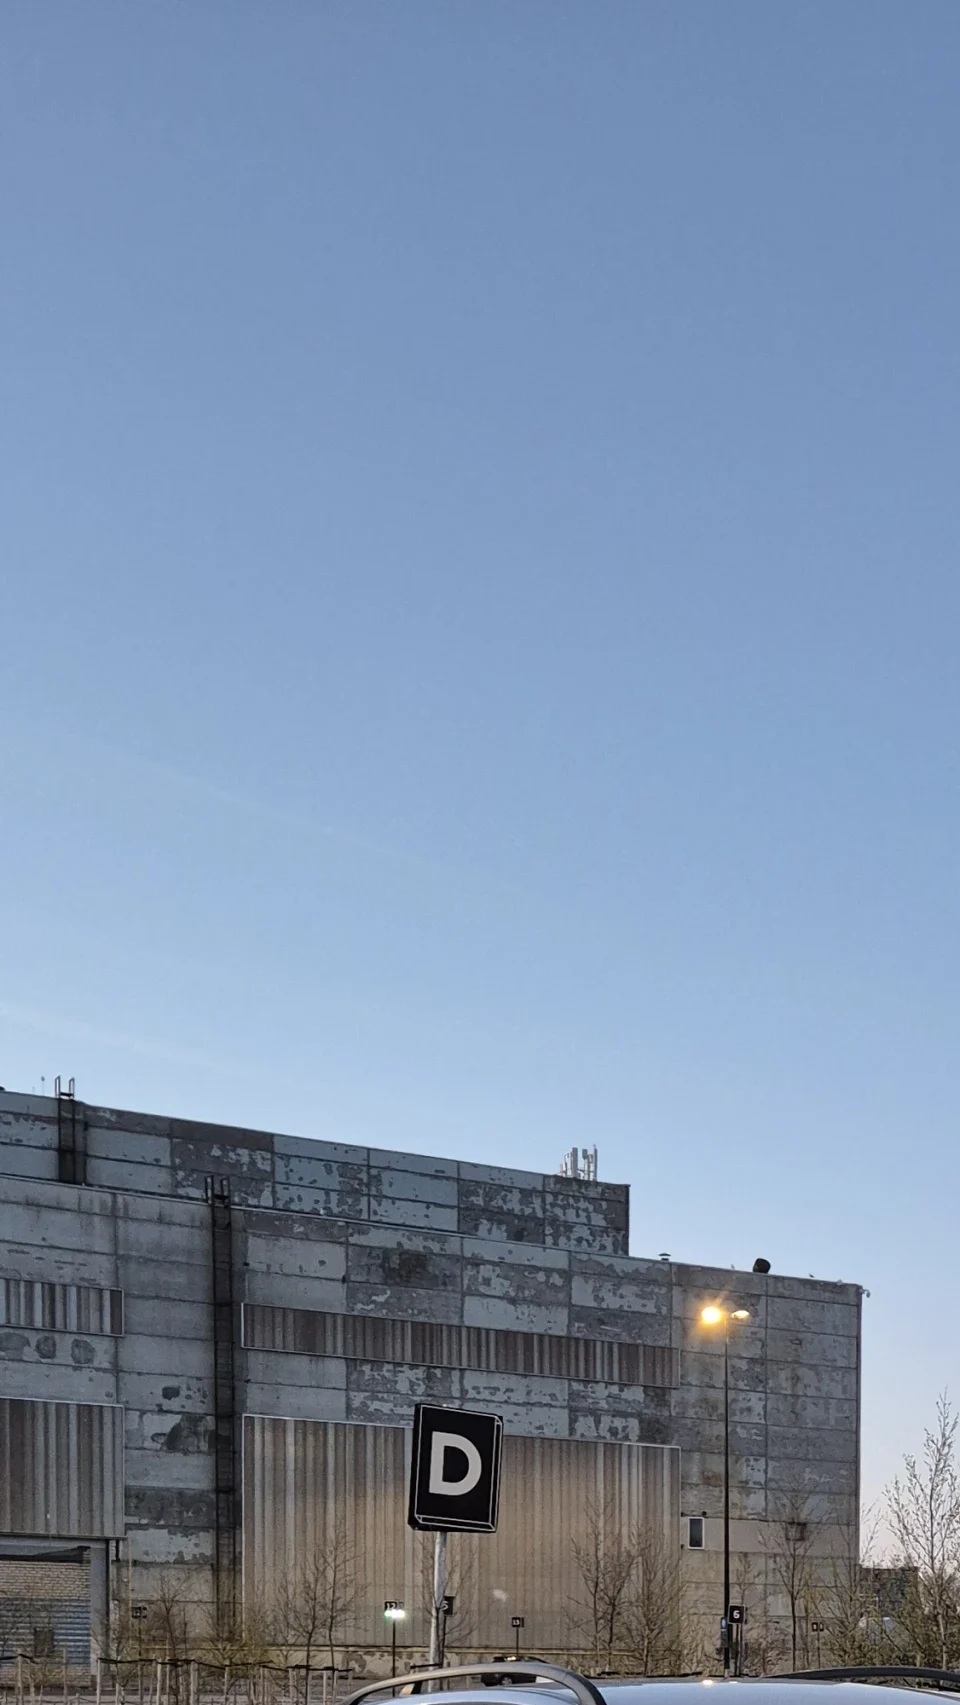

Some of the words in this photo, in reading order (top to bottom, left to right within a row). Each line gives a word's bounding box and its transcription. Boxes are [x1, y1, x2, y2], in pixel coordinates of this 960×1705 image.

[429, 1431, 482, 1496] D
[441, 1601, 449, 1610] 5
[733, 1610, 740, 1619] 6
